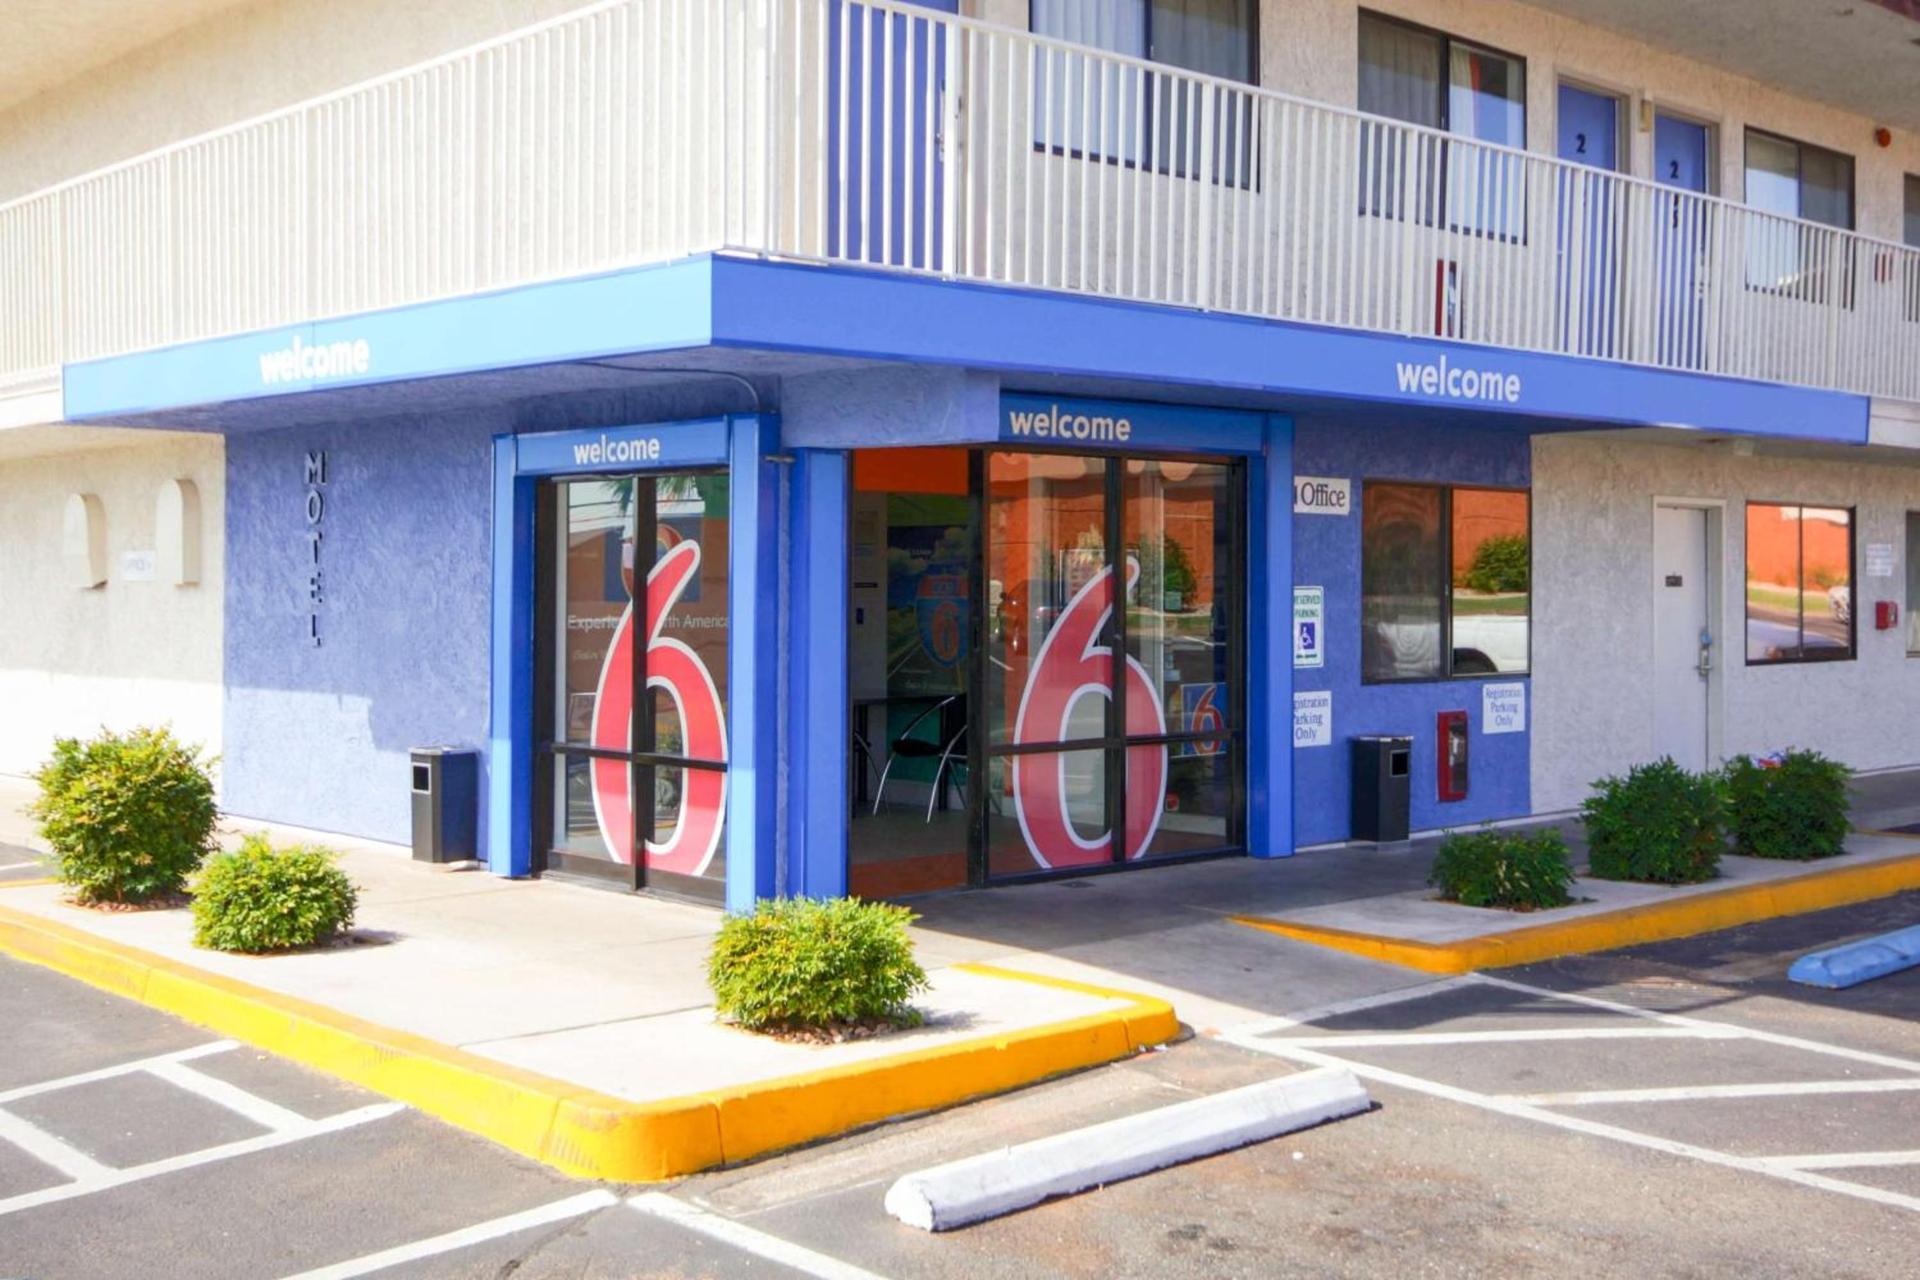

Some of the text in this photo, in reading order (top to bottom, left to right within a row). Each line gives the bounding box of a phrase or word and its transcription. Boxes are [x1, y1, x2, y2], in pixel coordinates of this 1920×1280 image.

[1576, 133, 1586, 154] 2
[259, 335, 369, 384] welcome
[1396, 354, 1520, 402] welcome
[1009, 404, 1131, 441] welcome
[573, 434, 660, 465] welcome
[1301, 482, 1345, 508] Office
[304, 451, 328, 648] MOTEL
[1294, 595, 1321, 605] ESERVED
[568, 614, 619, 633] Experie
[663, 614, 681, 628] rth
[590, 539, 728, 876] 6
[1012, 555, 1168, 868] 6
[1294, 697, 1329, 712] gistration
[1490, 702, 1518, 715] Parking
[1191, 684, 1224, 756] 6
[1495, 714, 1513, 728] Only
[1295, 726, 1318, 743] Only
